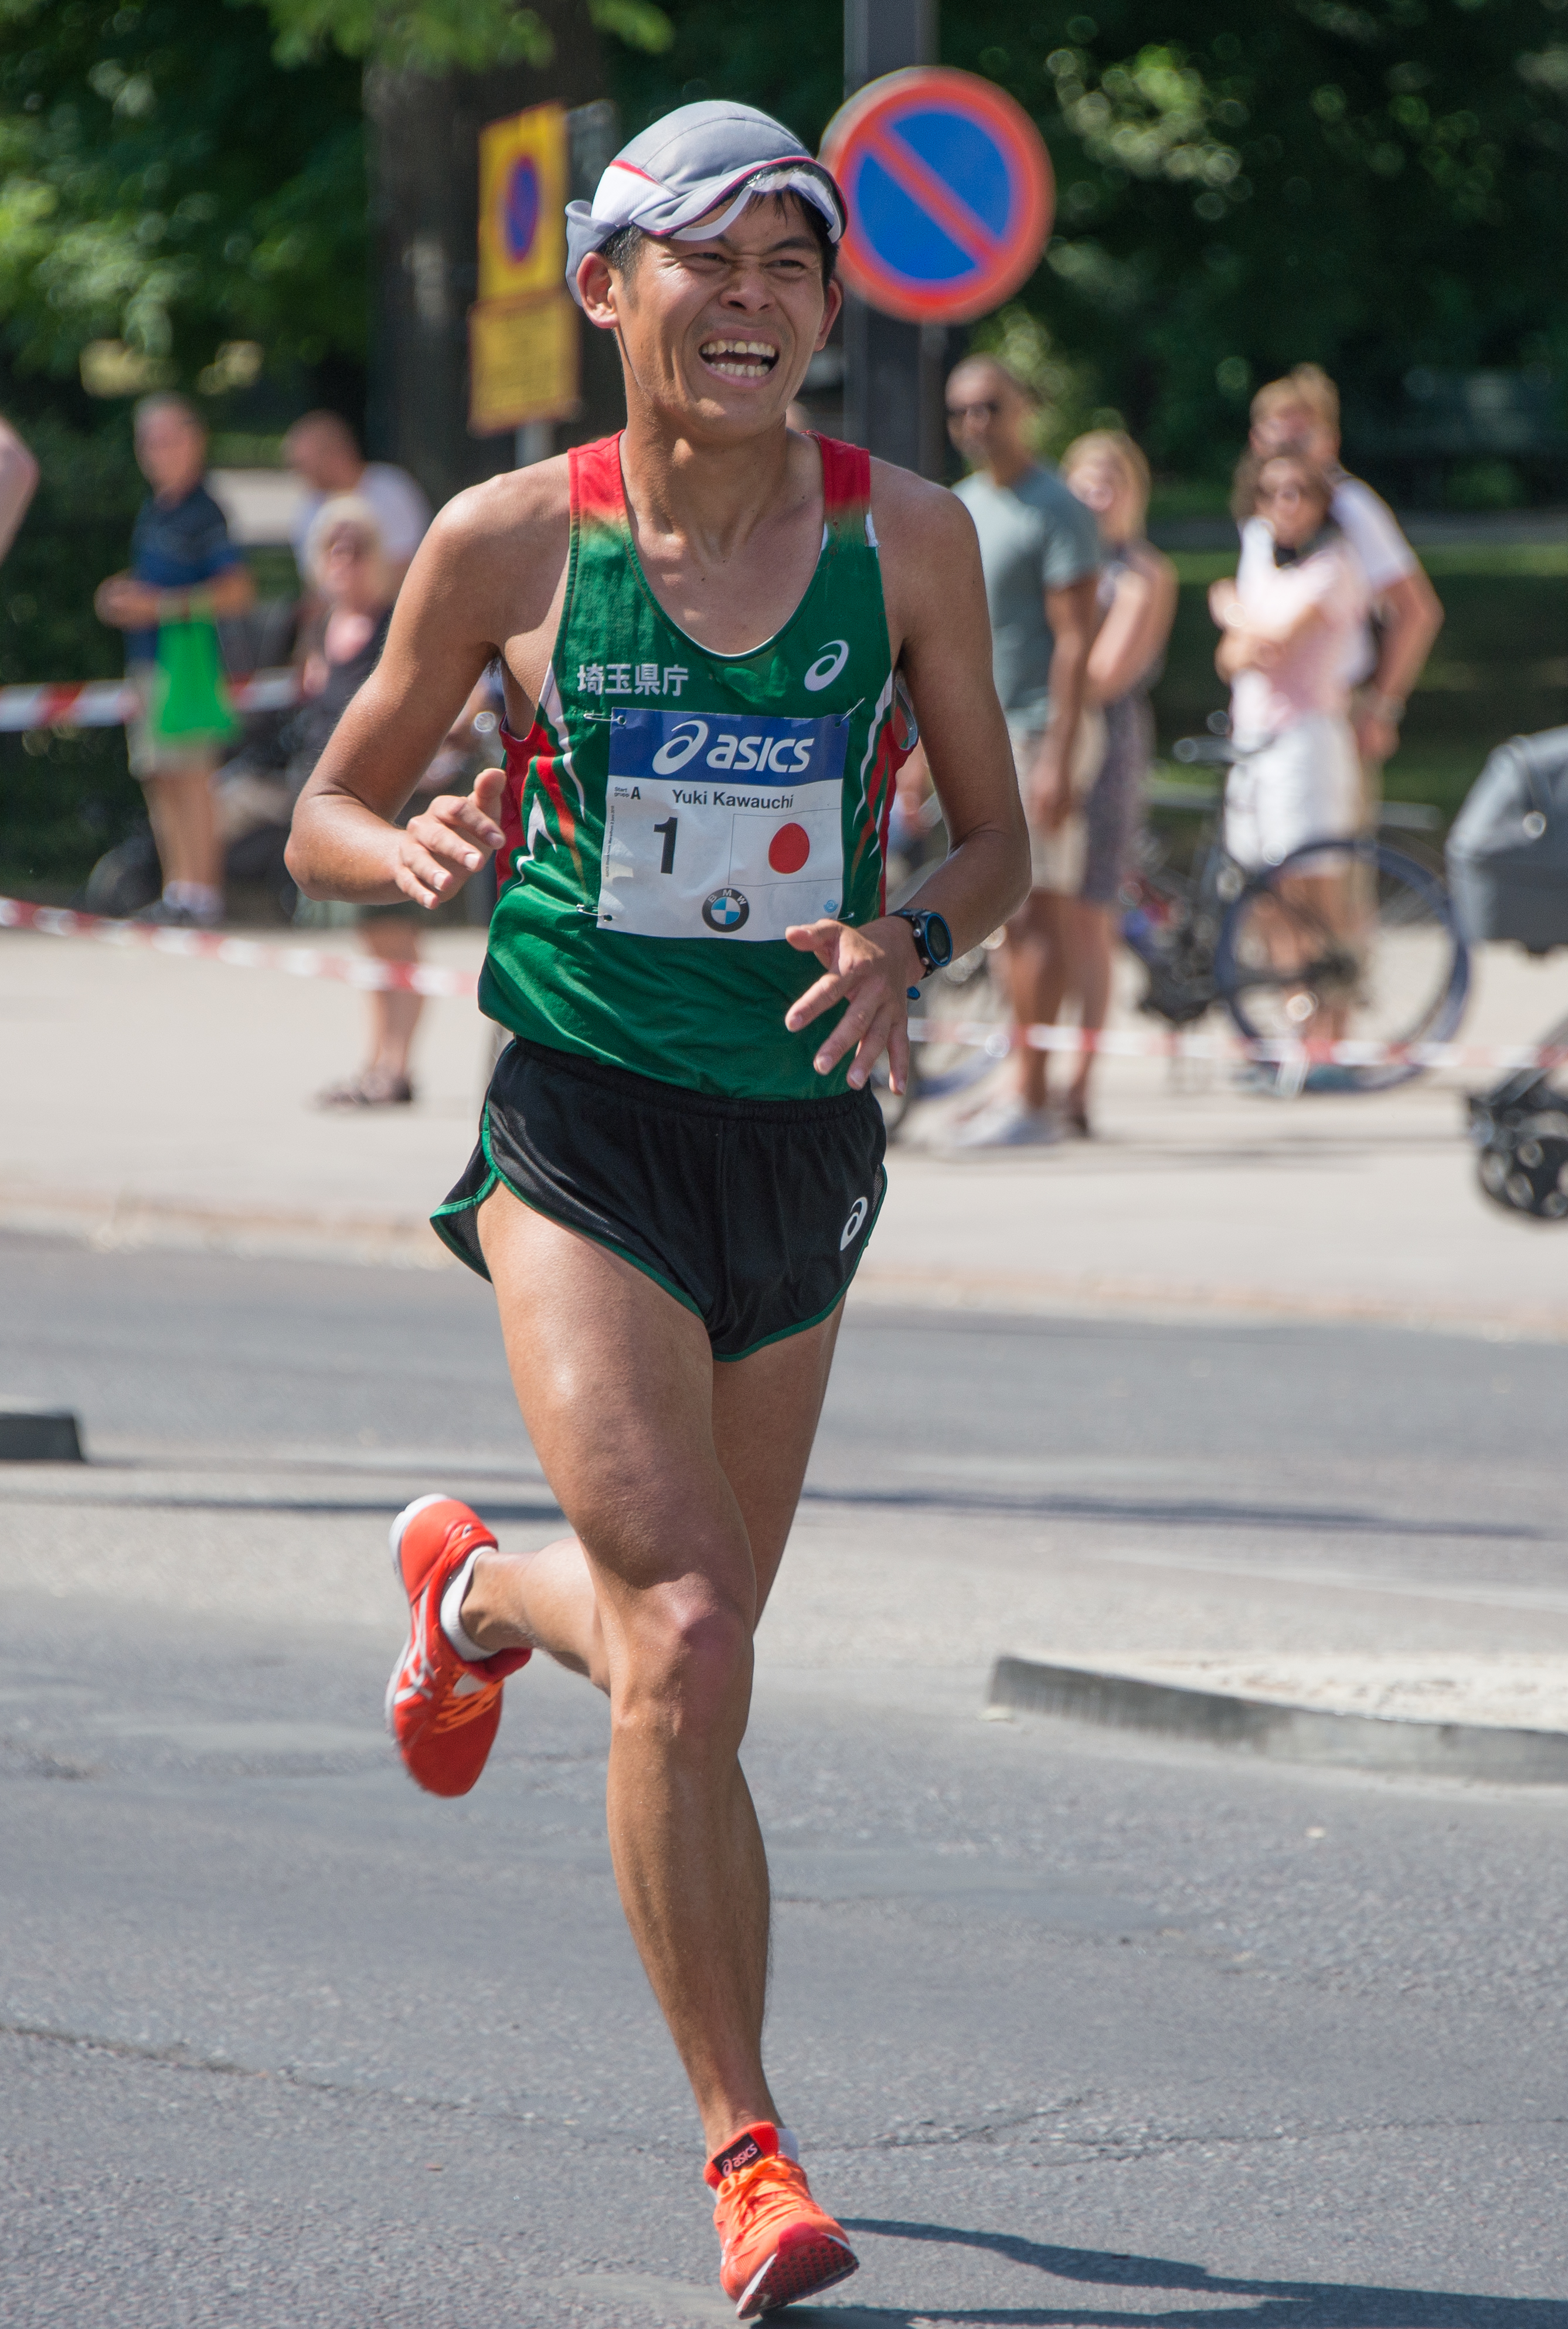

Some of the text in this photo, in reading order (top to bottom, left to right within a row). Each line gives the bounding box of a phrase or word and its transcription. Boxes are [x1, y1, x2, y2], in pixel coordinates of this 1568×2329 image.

[577, 663, 689, 697] 埼玉県庁
[706, 735, 815, 773] asics
[630, 786, 641, 800] A
[672, 790, 794, 809] Yuki Kawauchi
[654, 817, 678, 874] 1
[708, 889, 747, 905] BMW
